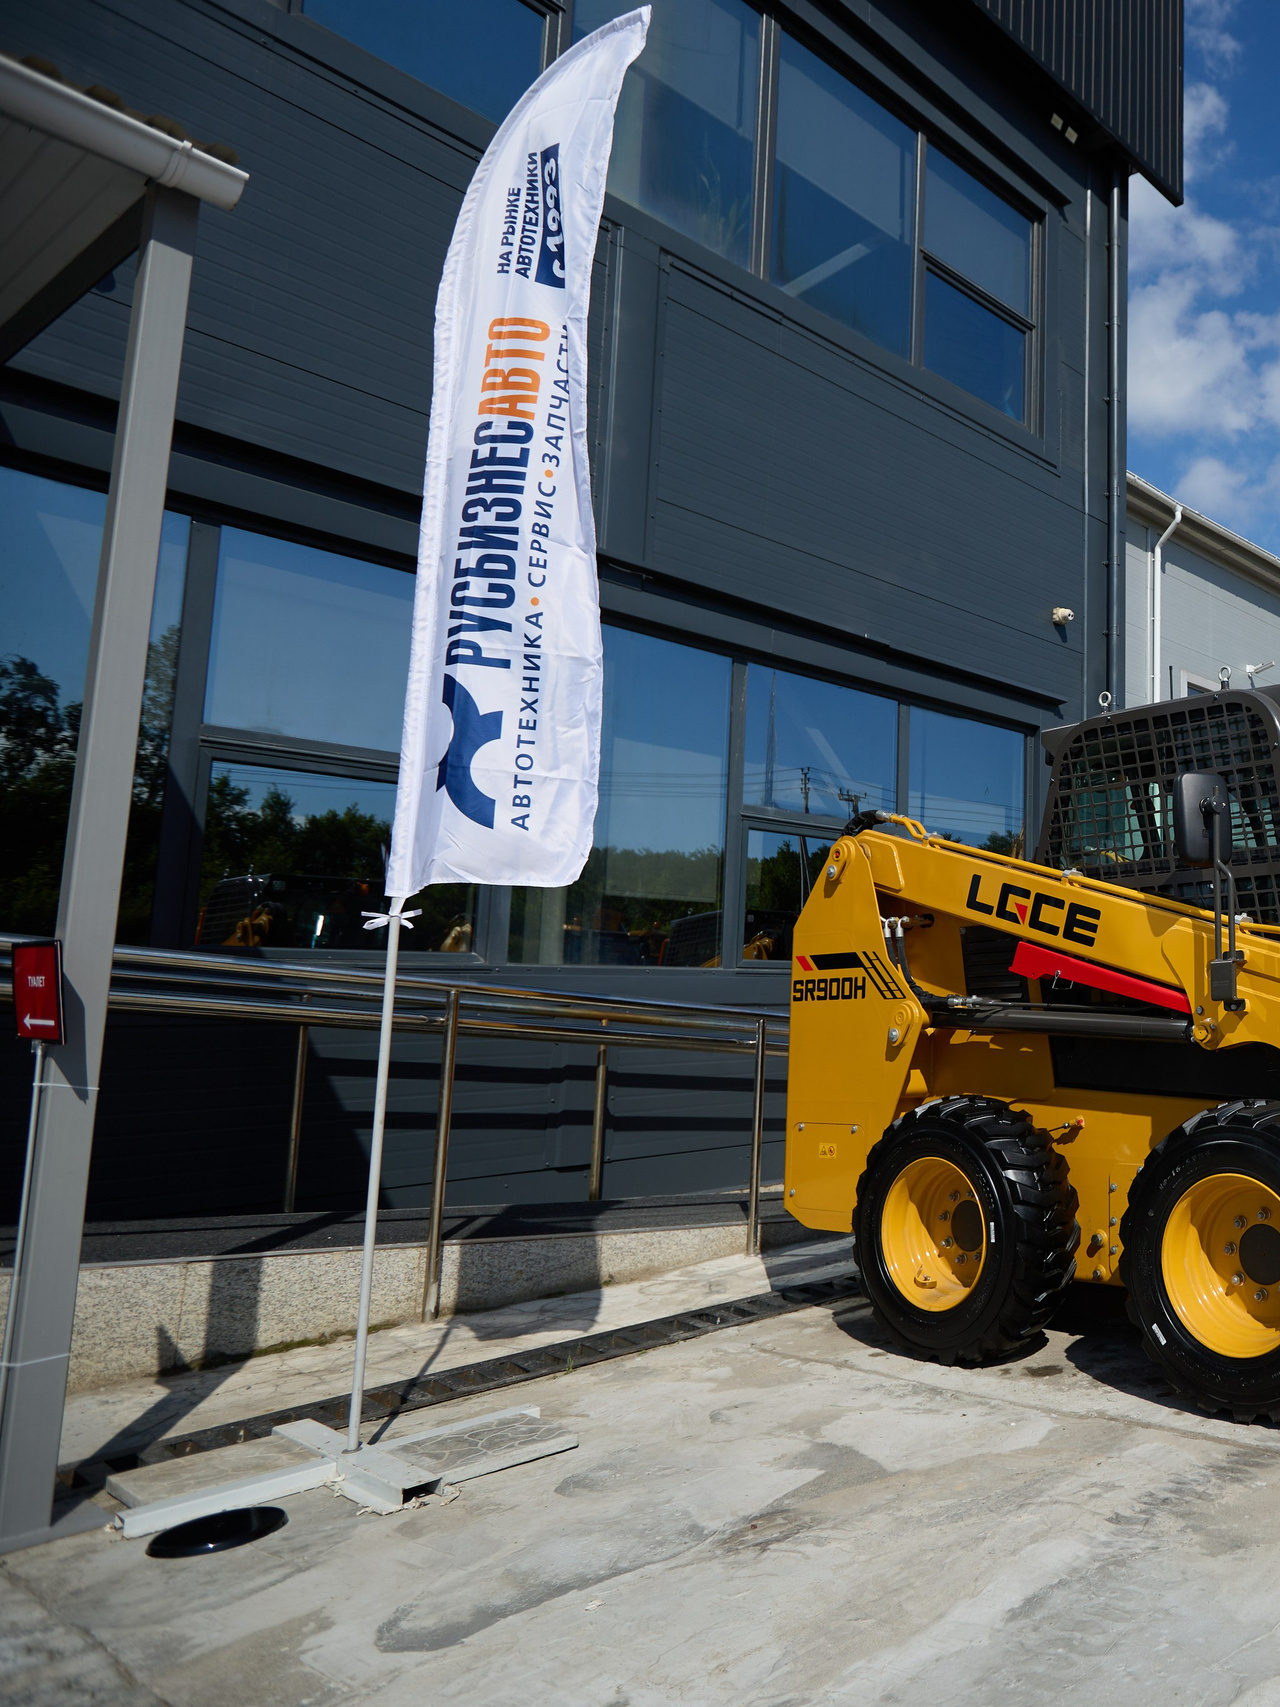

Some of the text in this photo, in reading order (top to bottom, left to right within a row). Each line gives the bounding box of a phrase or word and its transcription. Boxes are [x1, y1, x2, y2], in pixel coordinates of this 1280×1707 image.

[496, 187, 522, 275] НА РЫНКЕ
[514, 151, 539, 280] АВТОТЕХНИКИ
[445, 317, 551, 669] РУСБИЗНЕСАВТО
[526, 480, 558, 588] СЕРВИС
[510, 611, 545, 832] АВТОТЕХНИКА
[965, 873, 1102, 948] LGCE
[27, 975, 46, 988] ТУАЛЕТ
[792, 976, 867, 1002] SR900H
